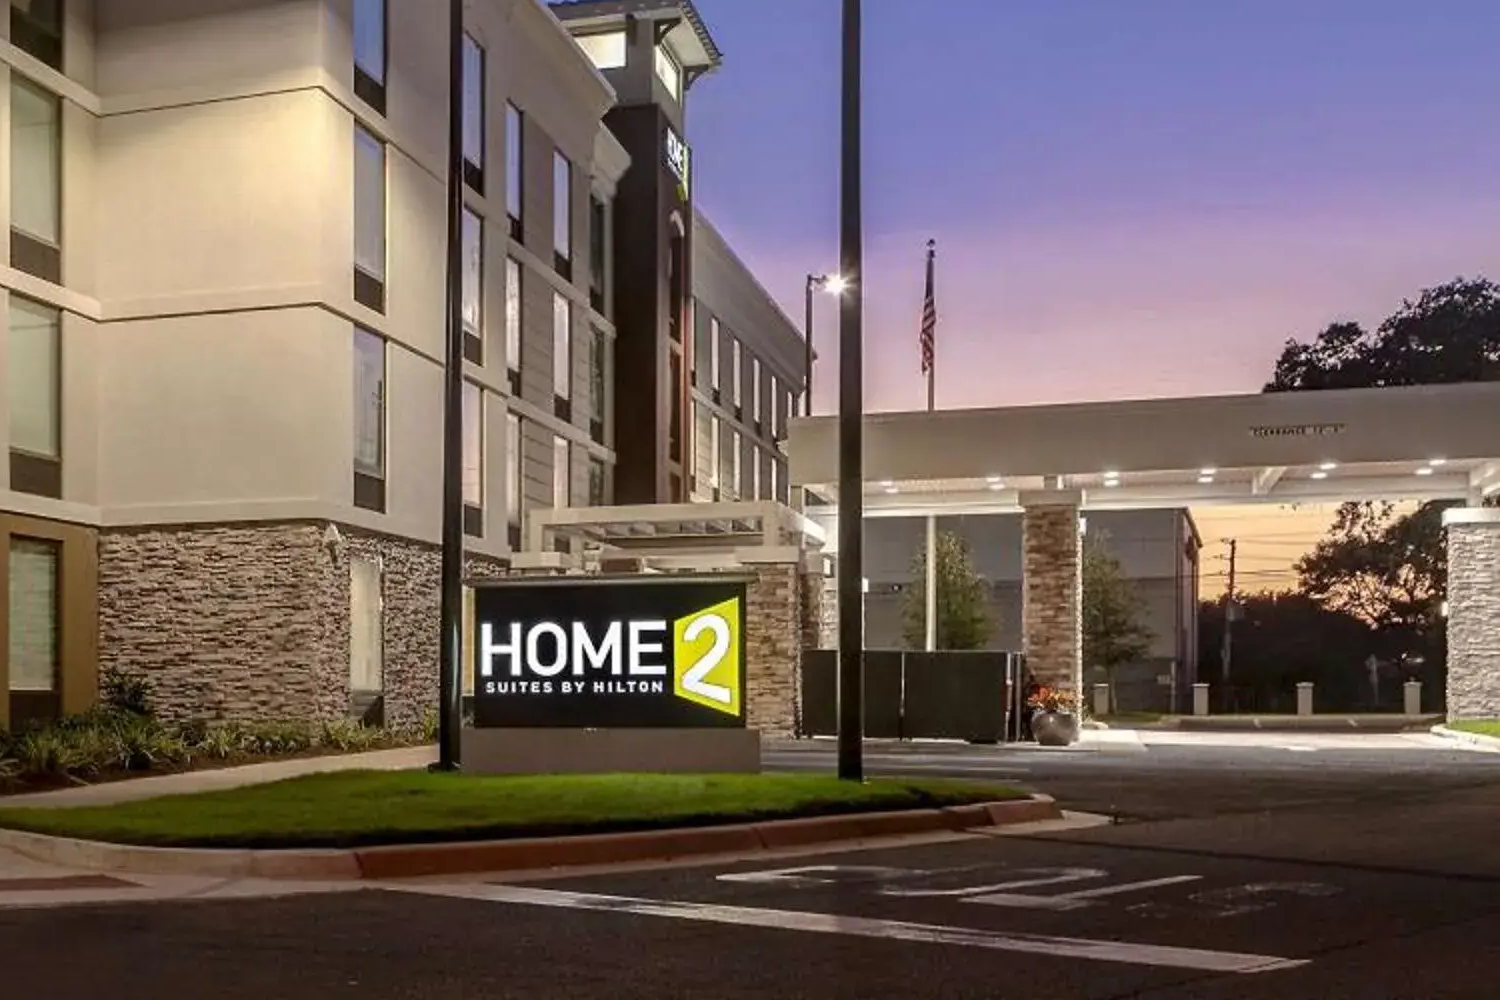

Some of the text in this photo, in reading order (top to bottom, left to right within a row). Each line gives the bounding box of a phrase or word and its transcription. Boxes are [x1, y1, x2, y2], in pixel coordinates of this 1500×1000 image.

[480, 614, 731, 703] HOME 2
[485, 681, 664, 694] SUITES BY HILTON
